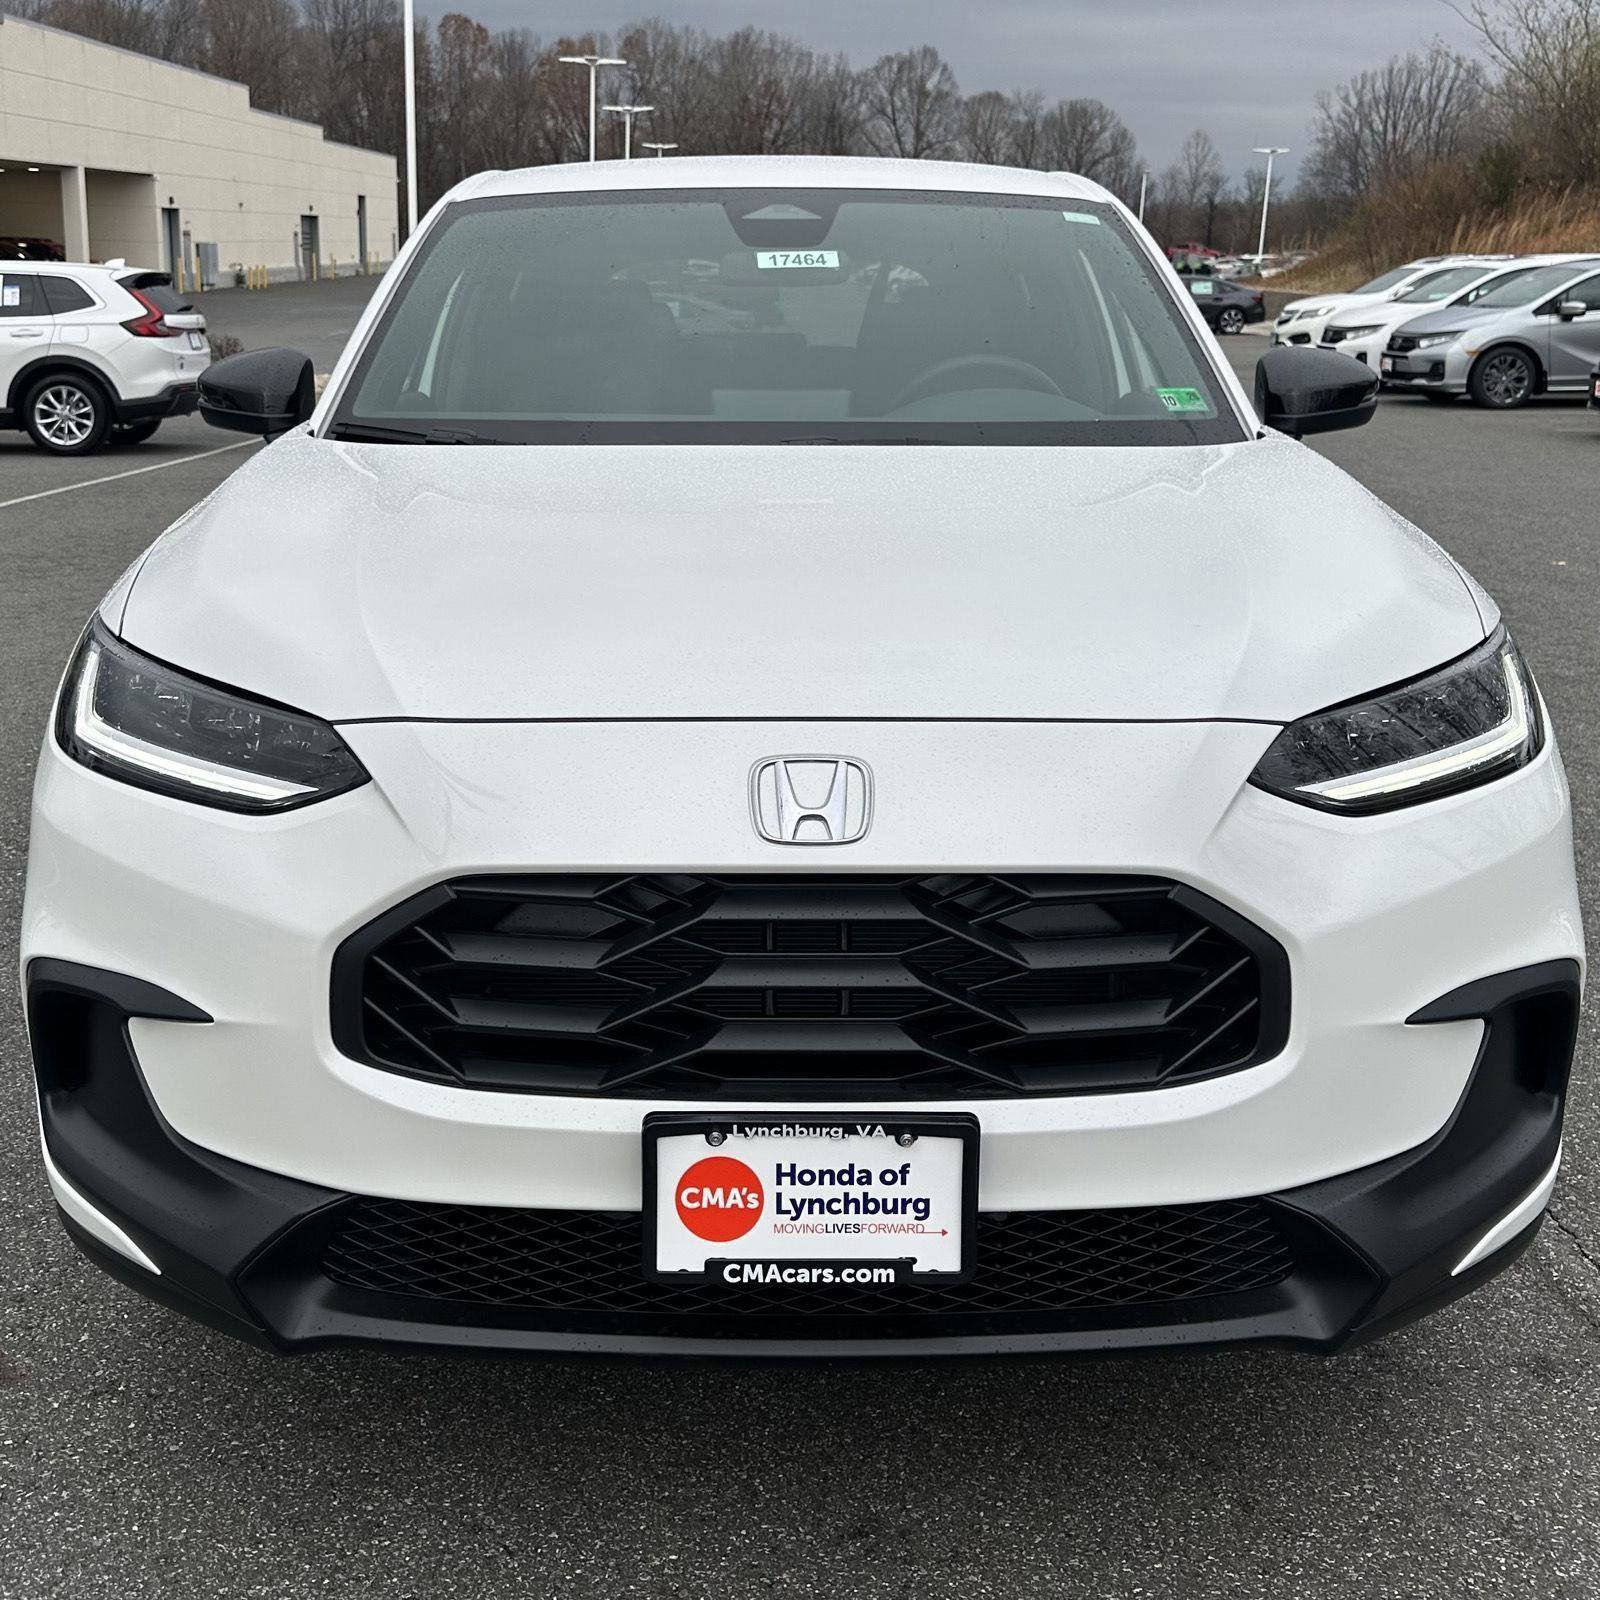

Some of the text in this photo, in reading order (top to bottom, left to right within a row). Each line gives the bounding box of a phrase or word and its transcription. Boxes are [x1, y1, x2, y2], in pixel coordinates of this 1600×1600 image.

[768, 253, 827, 266] 17464
[1163, 395, 1177, 406] 10
[732, 1124, 888, 1140] Lynchburg, VA
[775, 1163, 910, 1186] Honda of
[680, 1187, 760, 1209] CMA's
[775, 1192, 931, 1221] Lynchburg
[723, 1263, 895, 1283] CMAcars.com
